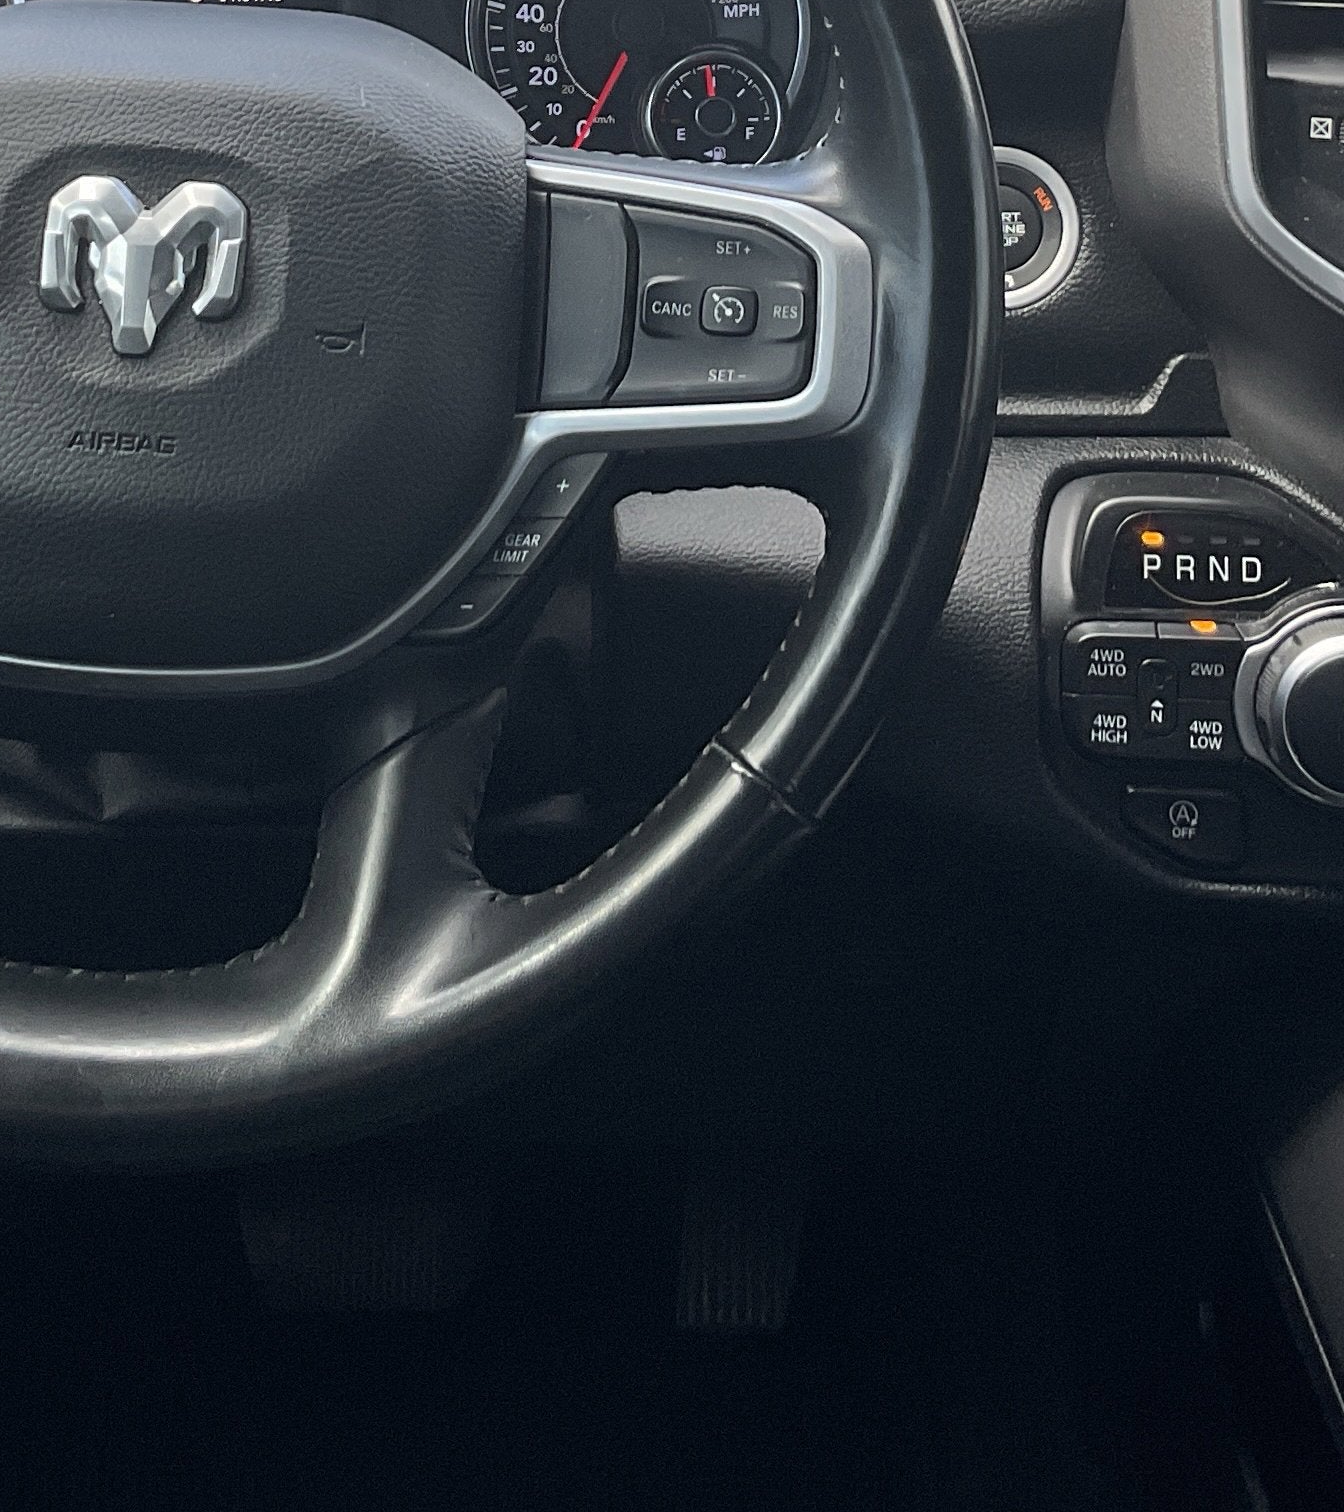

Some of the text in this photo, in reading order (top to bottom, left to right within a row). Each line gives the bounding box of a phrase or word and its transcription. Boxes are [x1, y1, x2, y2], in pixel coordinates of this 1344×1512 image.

[515, 3, 545, 24] 40
[723, 3, 761, 19] MPH
[539, 22, 554, 33] 60
[516, 40, 535, 54] 30
[544, 53, 558, 64] 40
[528, 66, 558, 86] 20
[561, 84, 575, 95] 20
[545, 102, 563, 116] 10
[676, 128, 686, 141] E
[745, 126, 755, 140] F
[1034, 186, 1054, 212] RUN
[651, 300, 693, 318] CANC
[772, 305, 798, 320] RES
[67, 429, 179, 456] AIRBAG
[505, 534, 541, 548] GEAR
[492, 550, 530, 563] LIMIT
[1143, 553, 1262, 583] P R N D
[1090, 649, 1125, 664] 4WD
[1087, 662, 1127, 678] AUTO
[1190, 662, 1225, 677] 2WD
[1093, 714, 1127, 729] 4WD
[1150, 709, 1163, 724] N
[1189, 720, 1223, 735] 4WD
[1090, 728, 1128, 744] HIGH
[1189, 735, 1223, 750] LOW
[1171, 827, 1196, 839] OFF
